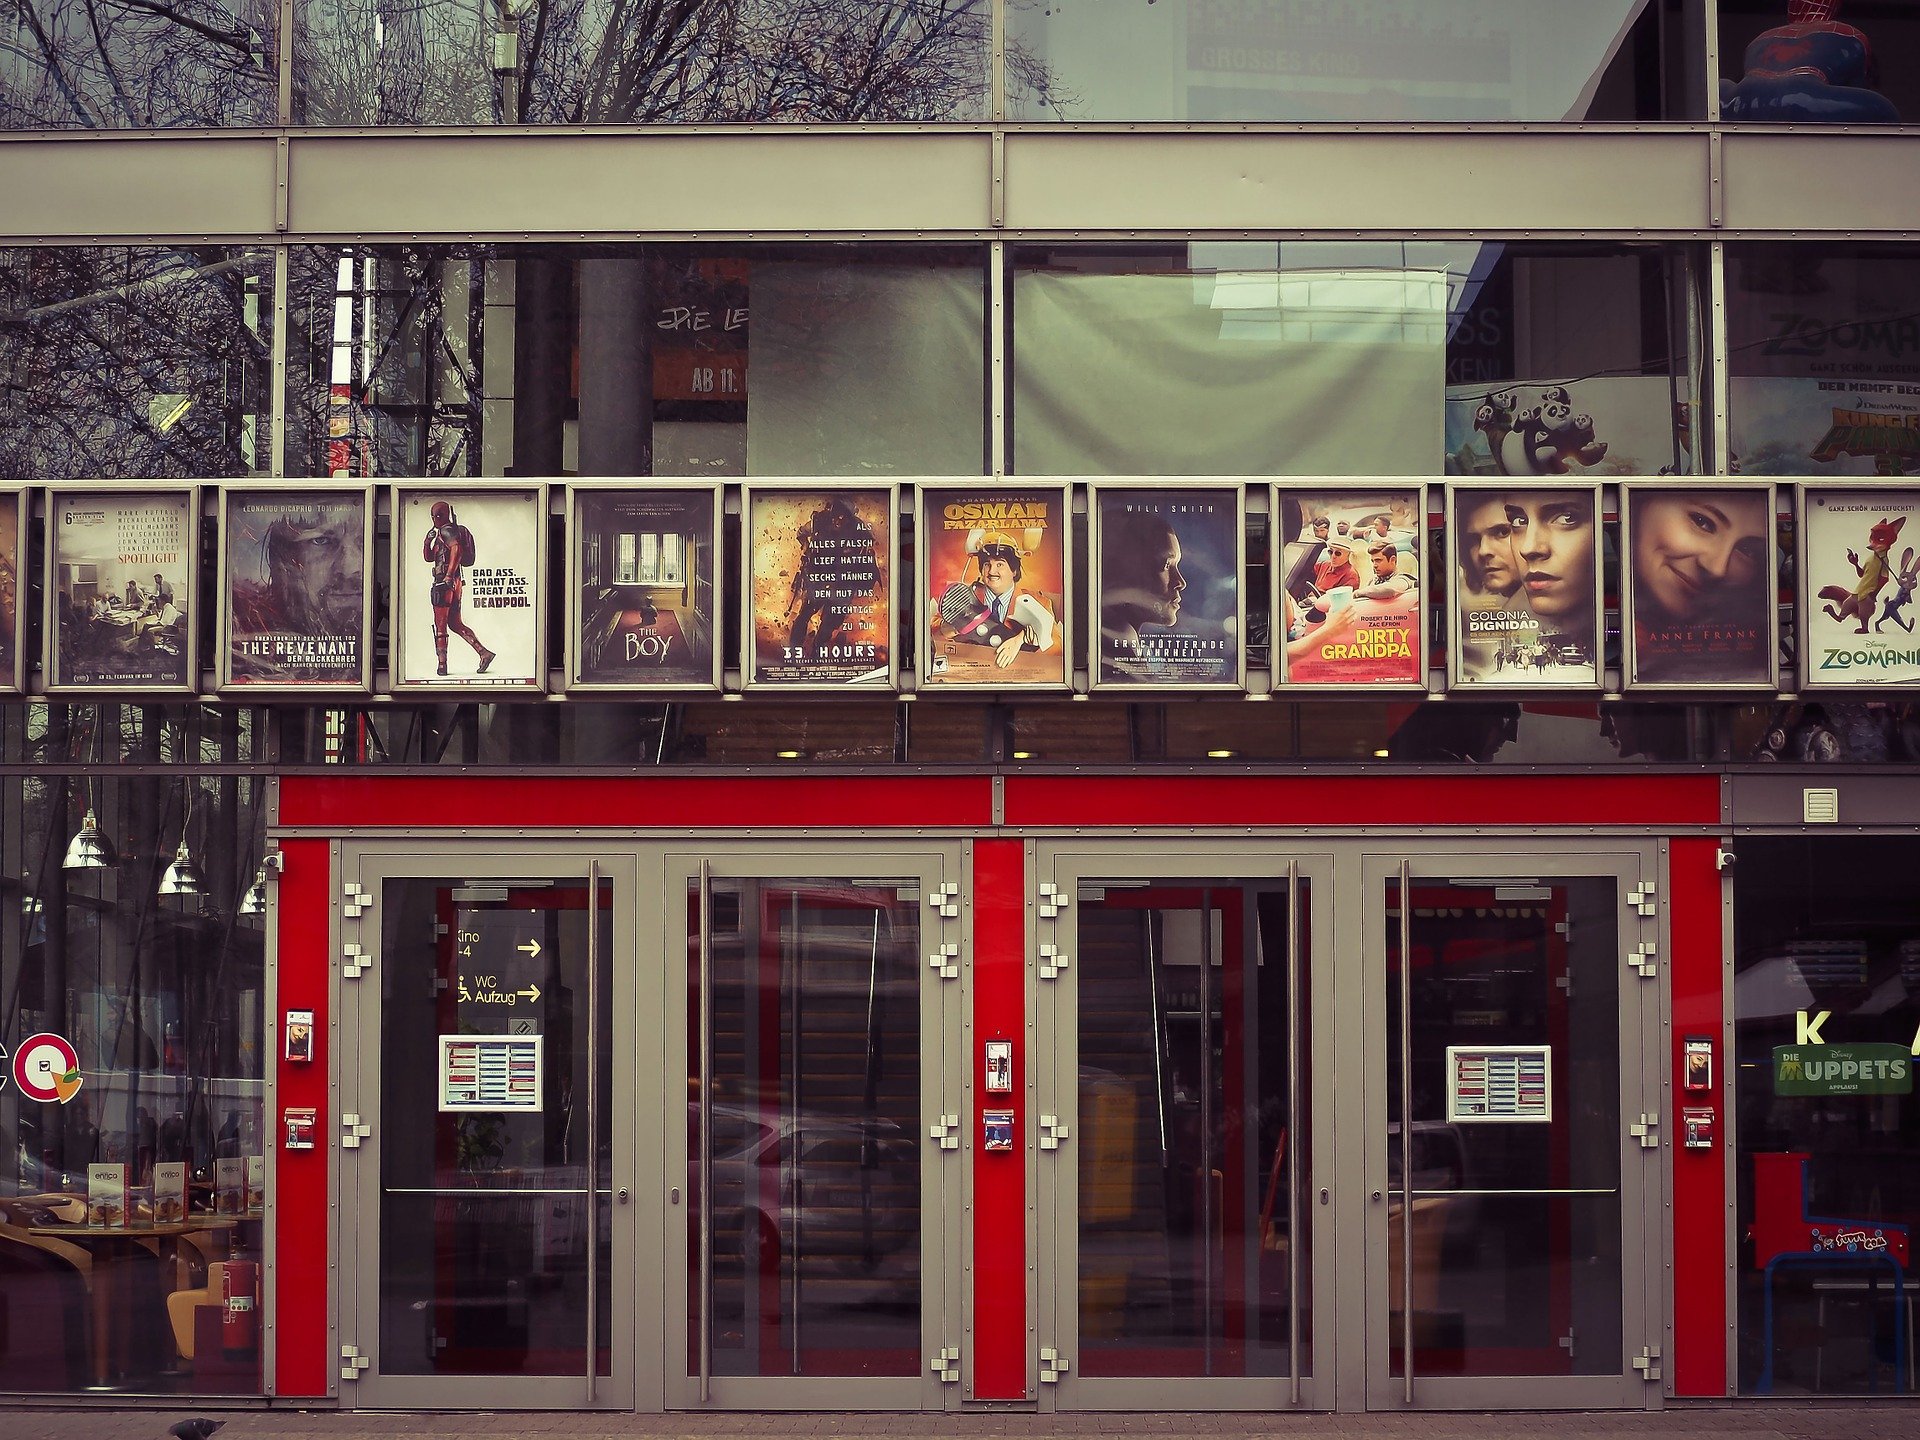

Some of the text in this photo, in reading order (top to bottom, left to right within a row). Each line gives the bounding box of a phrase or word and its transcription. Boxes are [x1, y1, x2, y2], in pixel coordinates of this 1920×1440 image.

[1203, 49, 1360, 75] GROSSES KINO
[692, 367, 714, 392] AB
[720, 368, 738, 392] 11.
[1818, 381, 1845, 391] DER
[1849, 383, 1894, 394] MAMPF
[944, 502, 1048, 520] OSMAN
[1126, 505, 1213, 513] WILL SMITH
[856, 523, 872, 531] ALS
[944, 519, 1048, 530] PAZARLAMA
[809, 539, 873, 548] ALLES FALSCH
[118, 553, 179, 564] SPOTLIGHT
[814, 556, 873, 565] LIEF HATTEN
[473, 568, 516, 577] BAD ASS.
[809, 571, 873, 582] SECHS MÄNNER
[473, 577, 529, 586] SMART ASS.
[473, 586, 527, 595] GREAT ASS.
[815, 590, 831, 598] DEN
[858, 589, 873, 597] DAS
[473, 597, 531, 608] DEADPOOL
[831, 606, 873, 614] RICHTIGE
[1469, 611, 1530, 621] COLONIA
[842, 622, 874, 631] ZU TUN
[1469, 620, 1539, 631] DIGNIDAD
[1356, 628, 1410, 644] DIRTY
[1650, 630, 1757, 641] ANNE FRANK
[241, 641, 356, 655] THE REVENANT
[625, 628, 673, 664] THE BOY
[1114, 639, 1224, 649] ERSCHÜTTERNDE
[820, 645, 875, 658] HOURS
[1136, 648, 1202, 657] WAHRHEIT
[1321, 643, 1412, 660] GRANDPA
[287, 655, 302, 663] DER
[475, 975, 497, 988] WC
[475, 990, 516, 1005] Aufzug
[1796, 1010, 1832, 1045] K
[1782, 1053, 1800, 1061] DIE
[1779, 1060, 1906, 1082] MUPPETS
